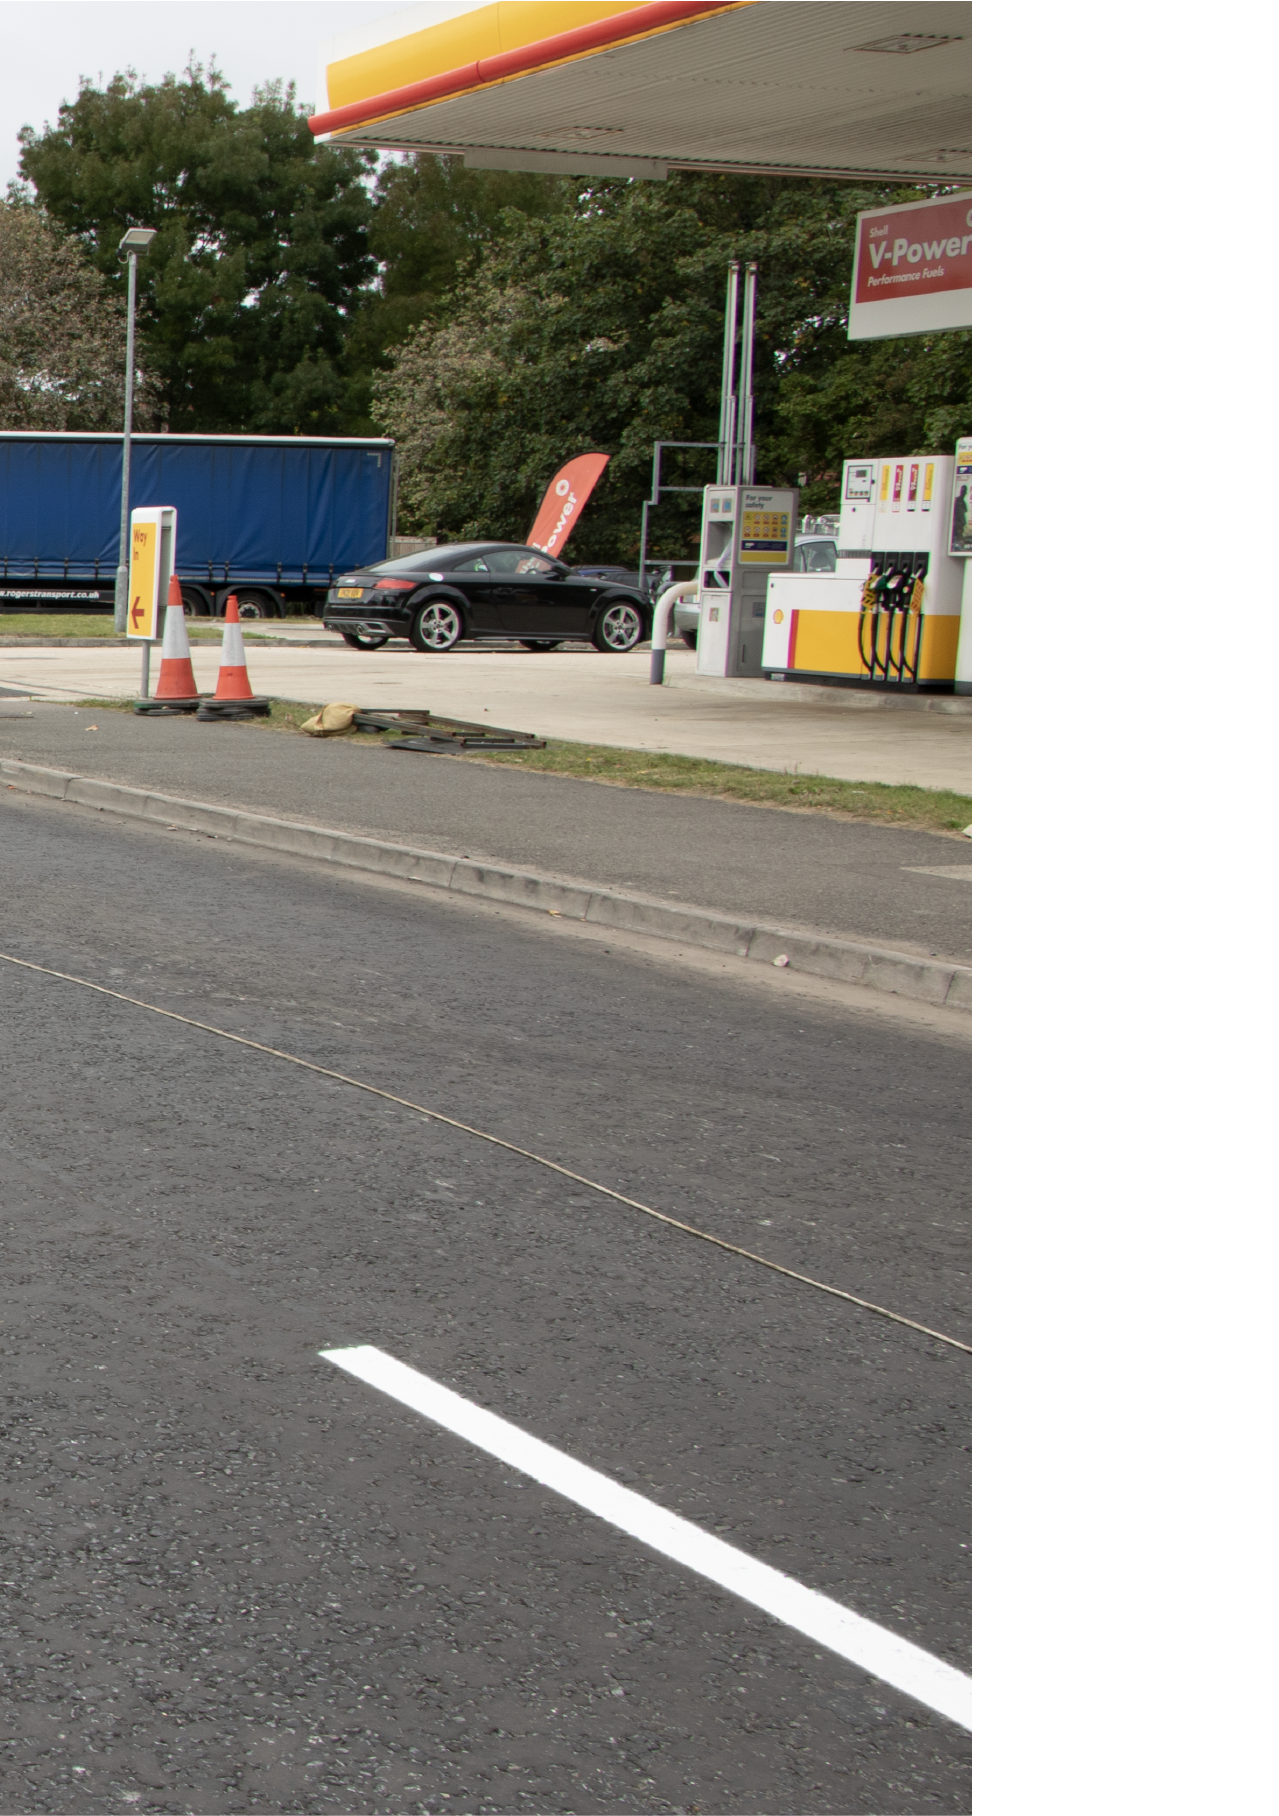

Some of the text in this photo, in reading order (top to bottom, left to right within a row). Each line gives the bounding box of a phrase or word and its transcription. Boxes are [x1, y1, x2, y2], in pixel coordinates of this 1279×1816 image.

[869, 225, 889, 238] Shell
[868, 234, 972, 269] V-Power
[867, 265, 945, 288] Performance Fuels
[133, 529, 148, 546] Way
[133, 547, 139, 560] In
